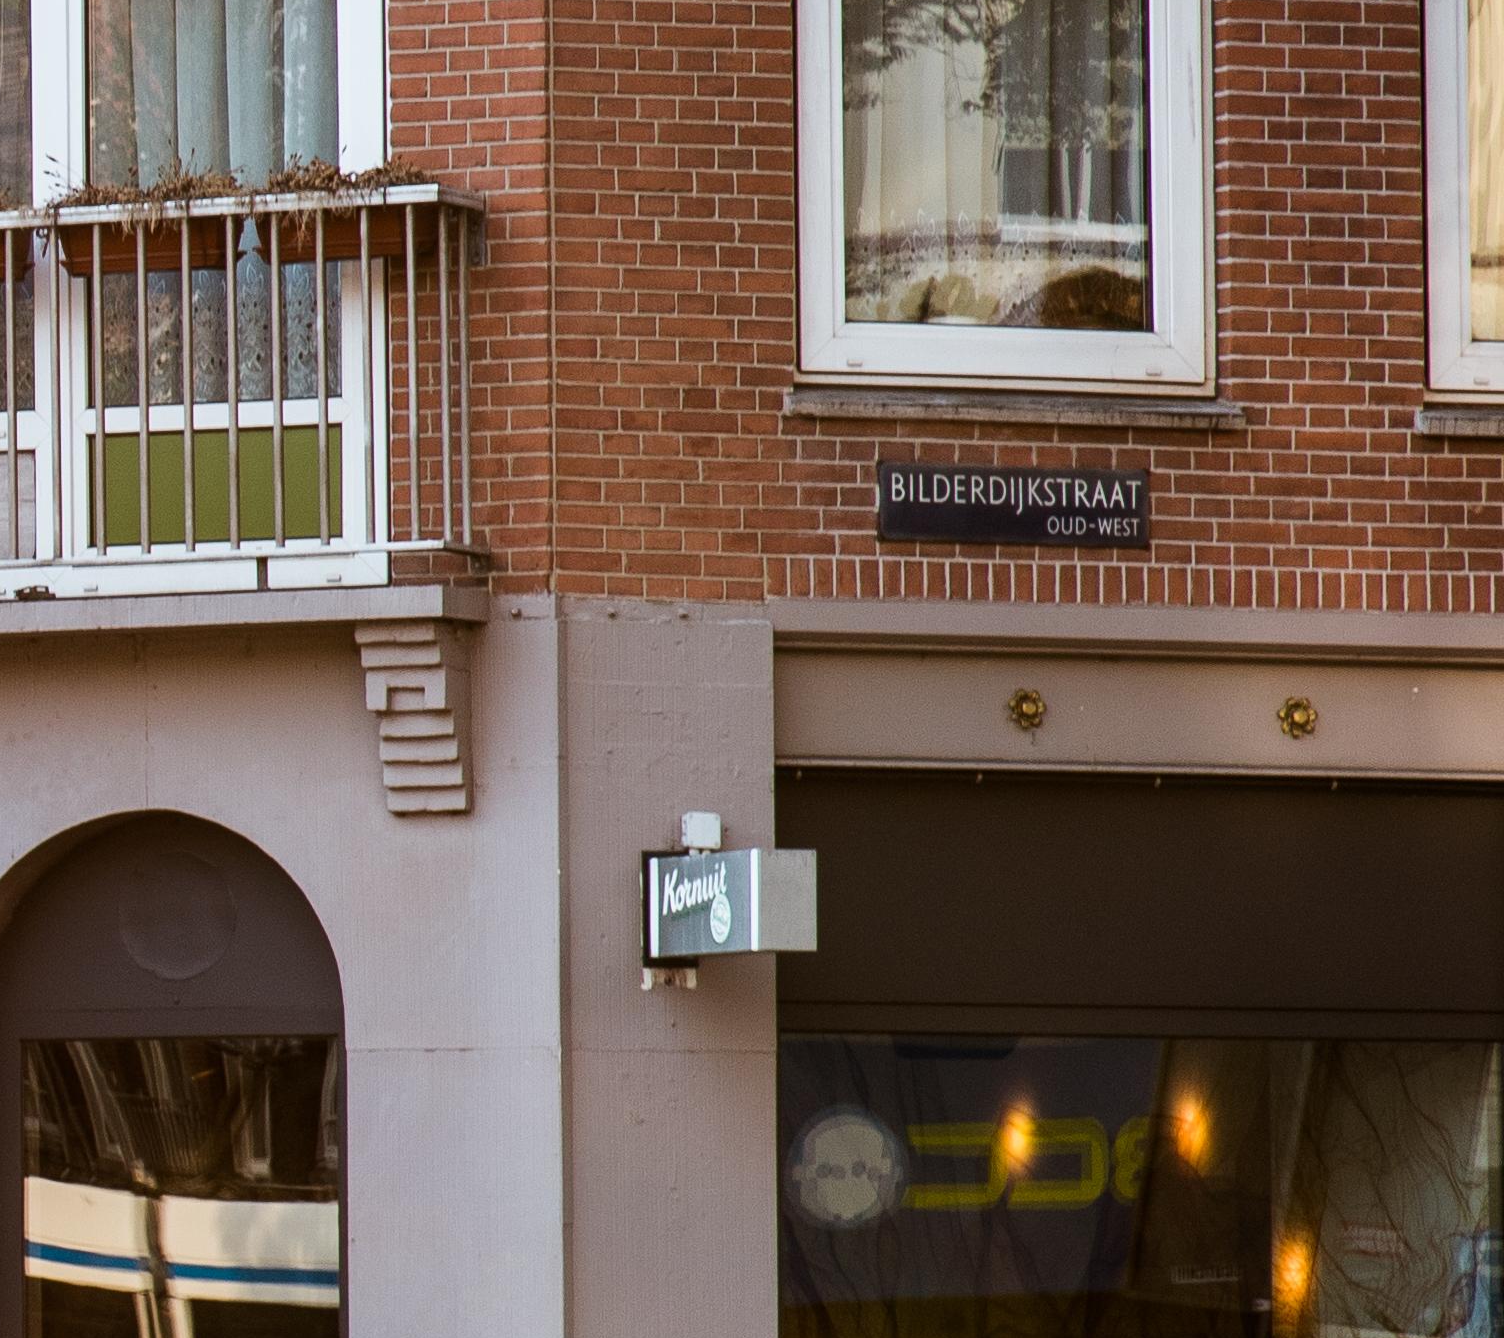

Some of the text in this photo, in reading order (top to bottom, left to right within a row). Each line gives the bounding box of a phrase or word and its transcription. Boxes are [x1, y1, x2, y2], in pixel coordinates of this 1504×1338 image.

[890, 472, 1142, 515] BILDERDIJKSTRAAT
[1047, 516, 1141, 537] OUD-WEST
[662, 861, 727, 915] Kornuit
